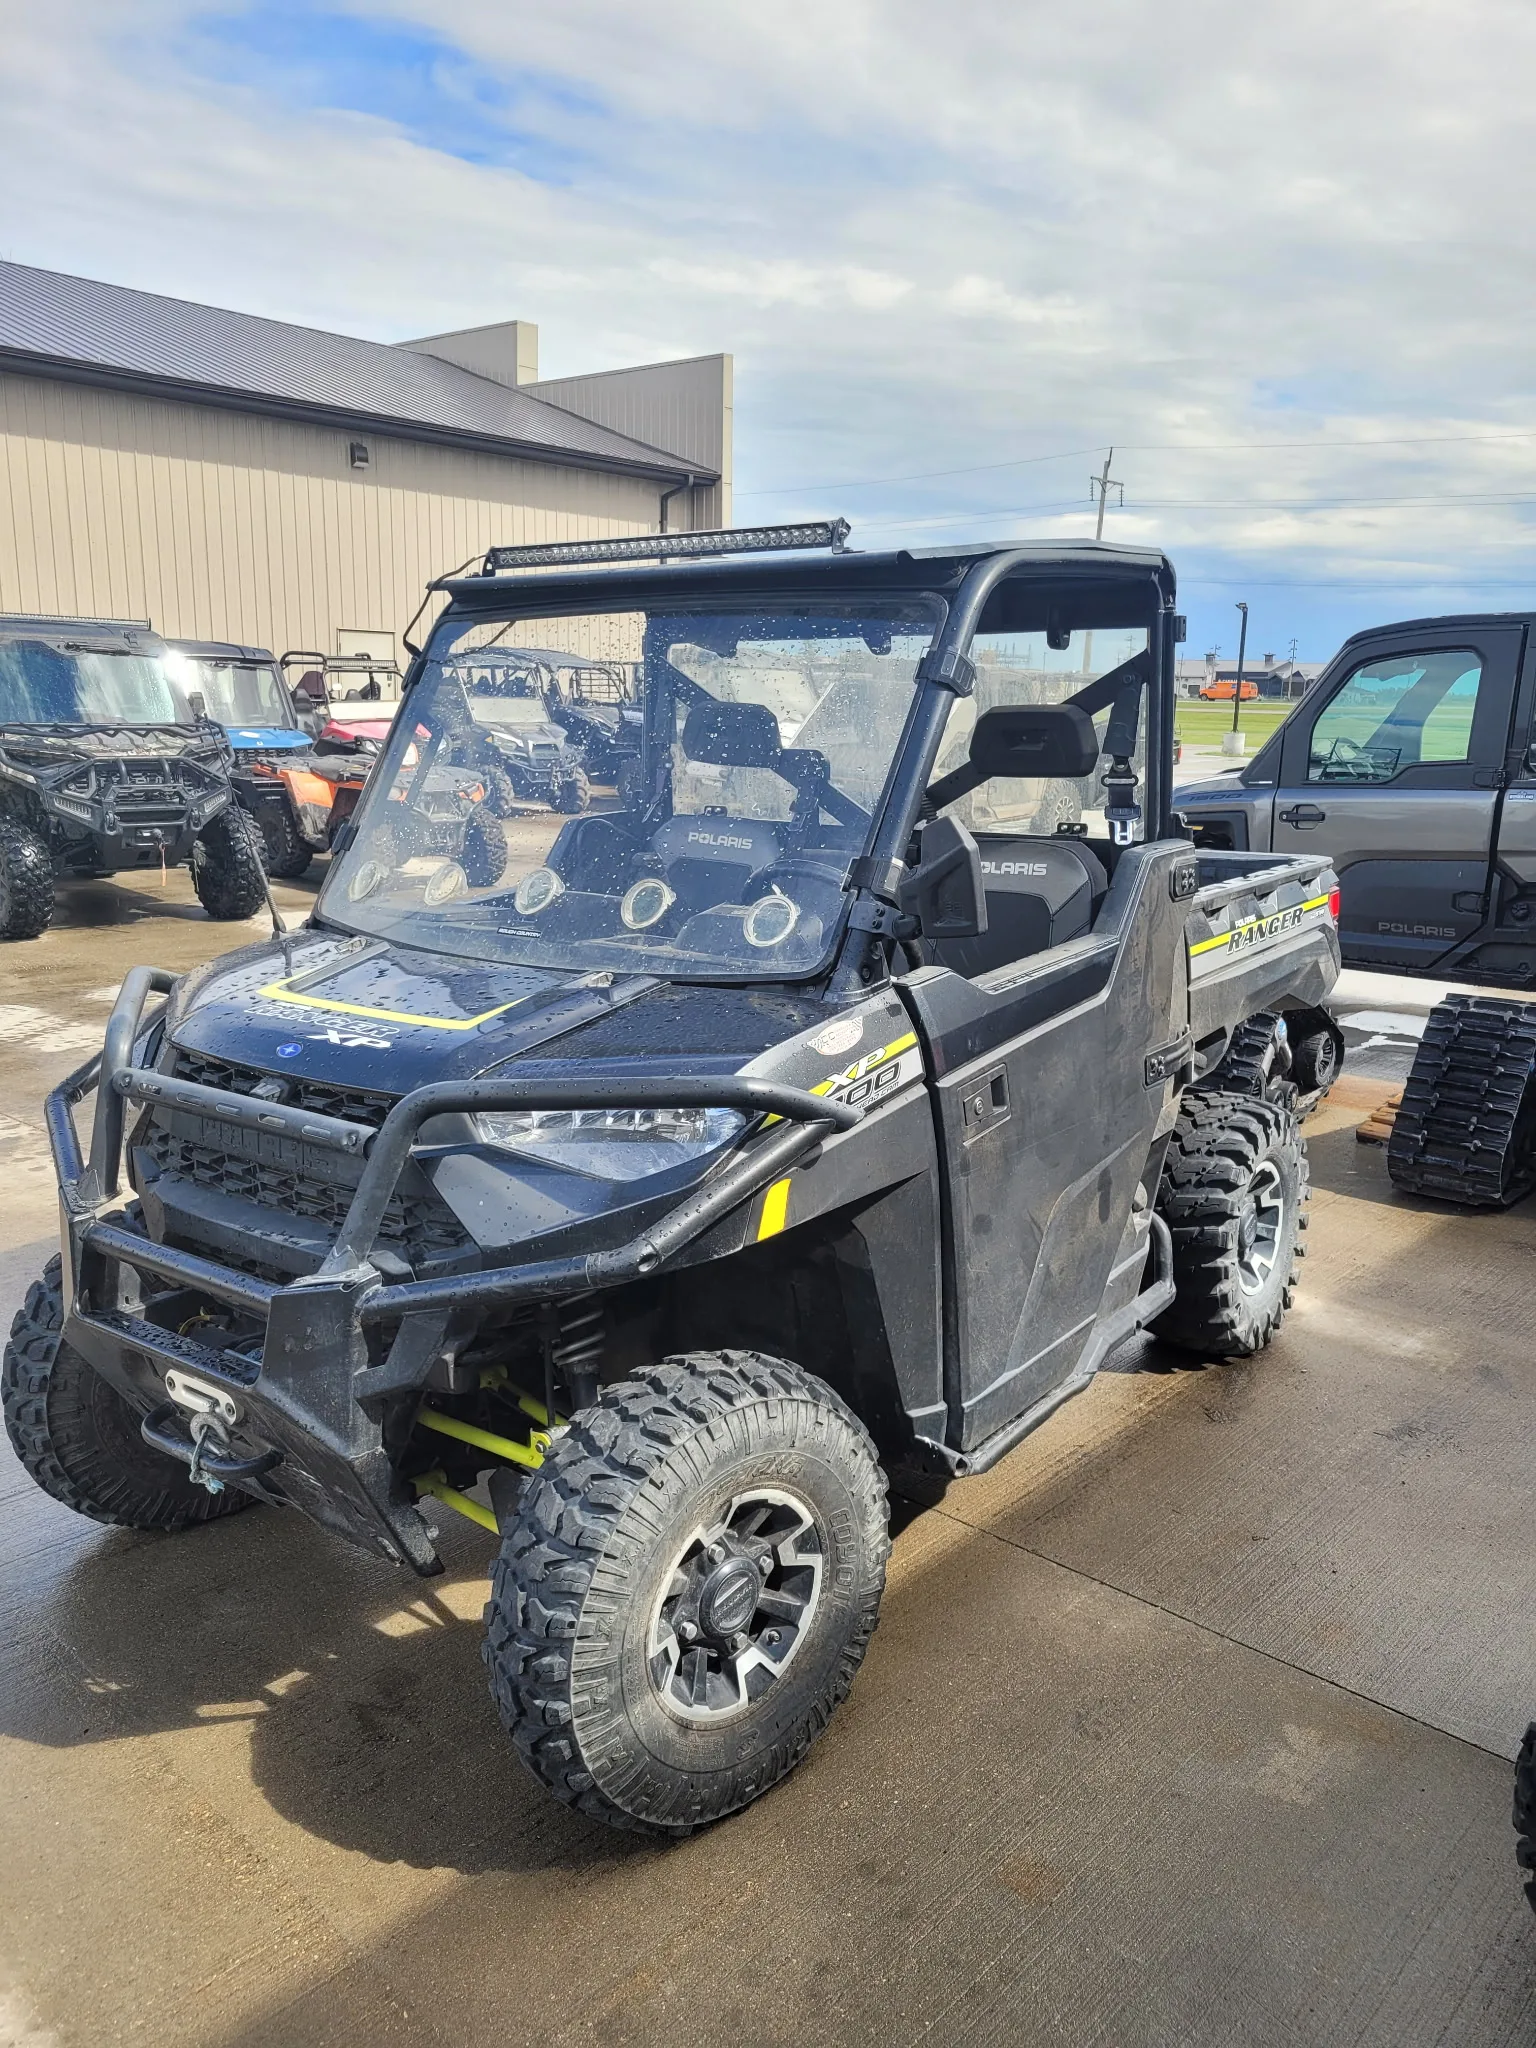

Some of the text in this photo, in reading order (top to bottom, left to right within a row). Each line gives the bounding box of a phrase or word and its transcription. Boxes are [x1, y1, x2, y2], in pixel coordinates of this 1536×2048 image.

[688, 832, 753, 849] POLARIS
[980, 861, 1047, 876] OLARIS
[1226, 906, 1304, 955] RANGER
[1234, 914, 1257, 929] POLARIS
[1378, 921, 1456, 937] POLARIS
[244, 1004, 400, 1038] RANGER
[305, 1028, 392, 1049] XP
[821, 1046, 888, 1098] XP
[832, 1060, 902, 1105] 00
